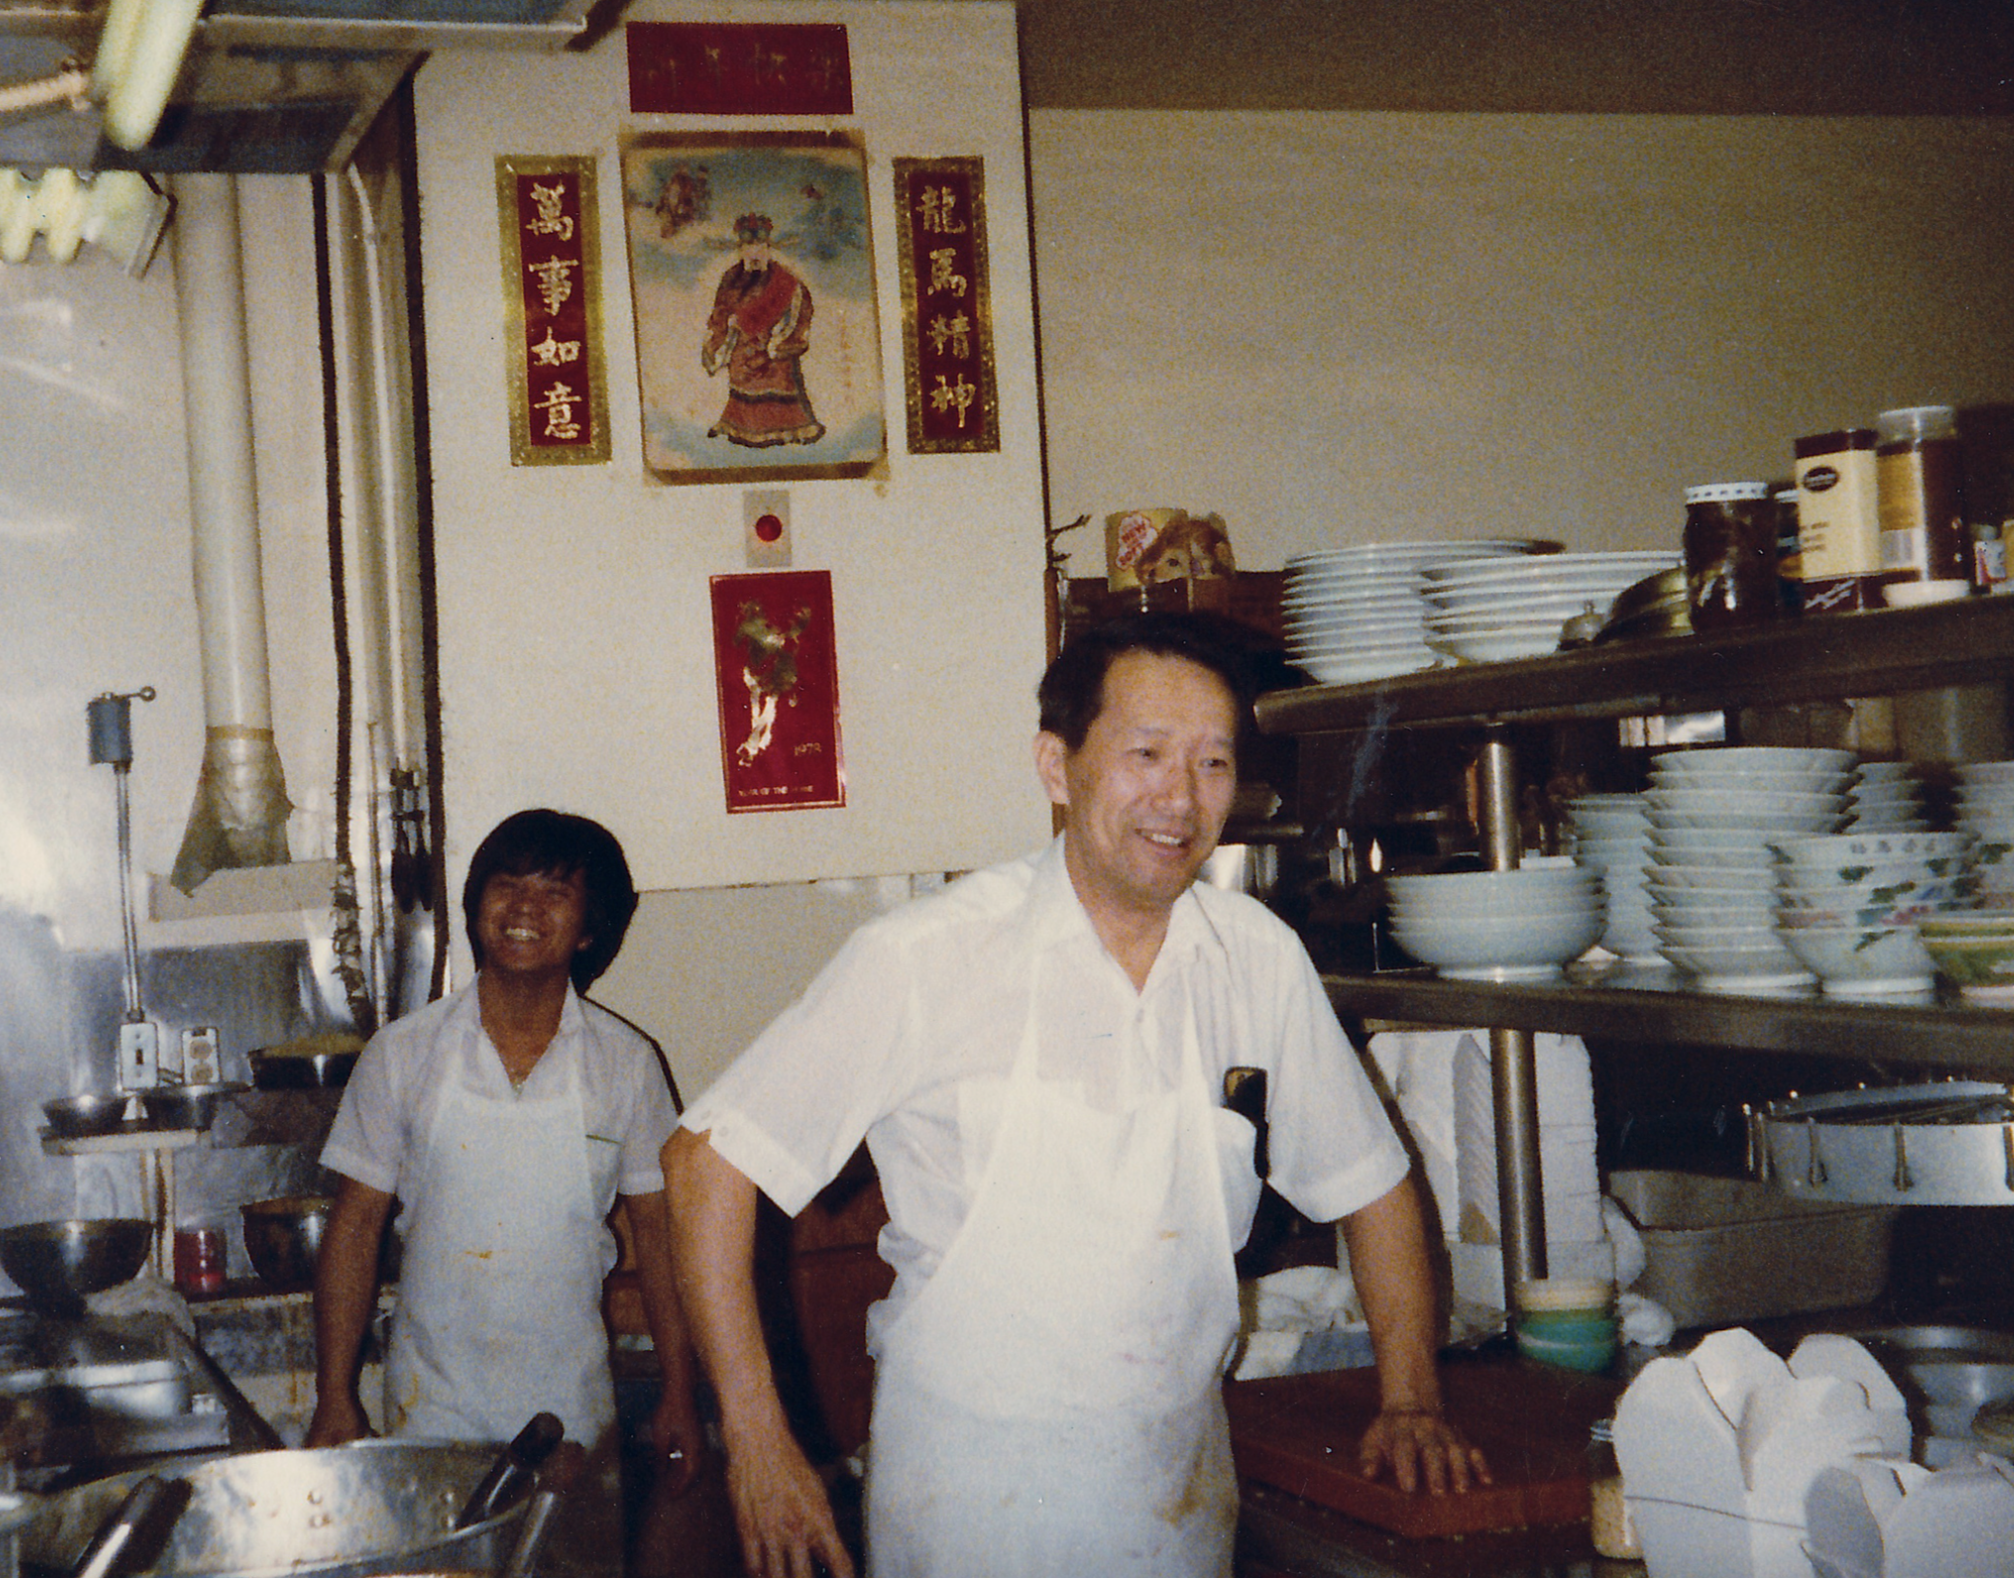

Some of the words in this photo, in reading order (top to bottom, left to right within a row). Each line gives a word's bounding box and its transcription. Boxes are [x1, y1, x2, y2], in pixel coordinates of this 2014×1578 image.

[525, 181, 582, 439] 萬事如意
[915, 185, 976, 429] 龍馬精神
